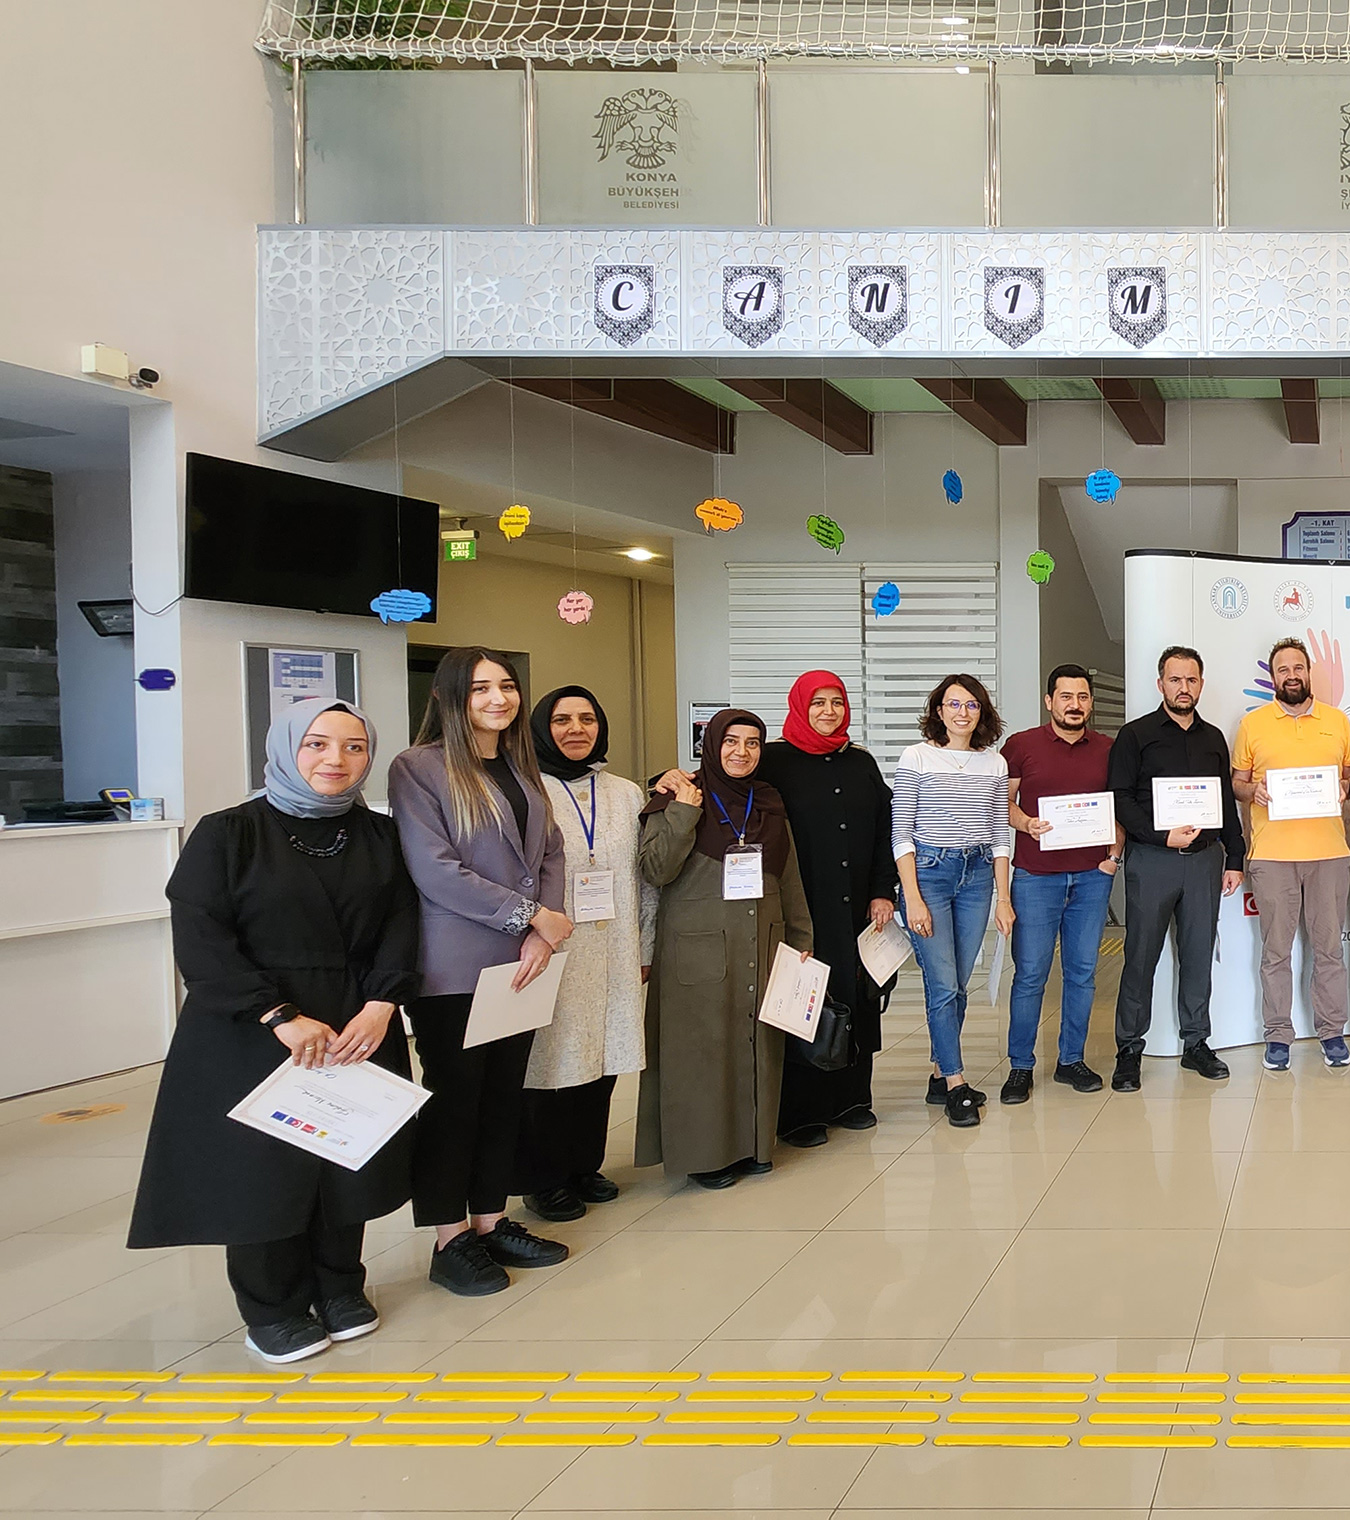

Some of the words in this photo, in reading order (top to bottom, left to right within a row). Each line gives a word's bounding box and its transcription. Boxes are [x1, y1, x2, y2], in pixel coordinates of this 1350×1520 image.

[626, 172, 677, 182] KONYA
[608, 186, 692, 199] BÜYÜKŞEH
[623, 200, 679, 209] BELEDİYESİ
[451, 542, 470, 550] EXIT
[451, 550, 469, 559] ÇIKIŞ
